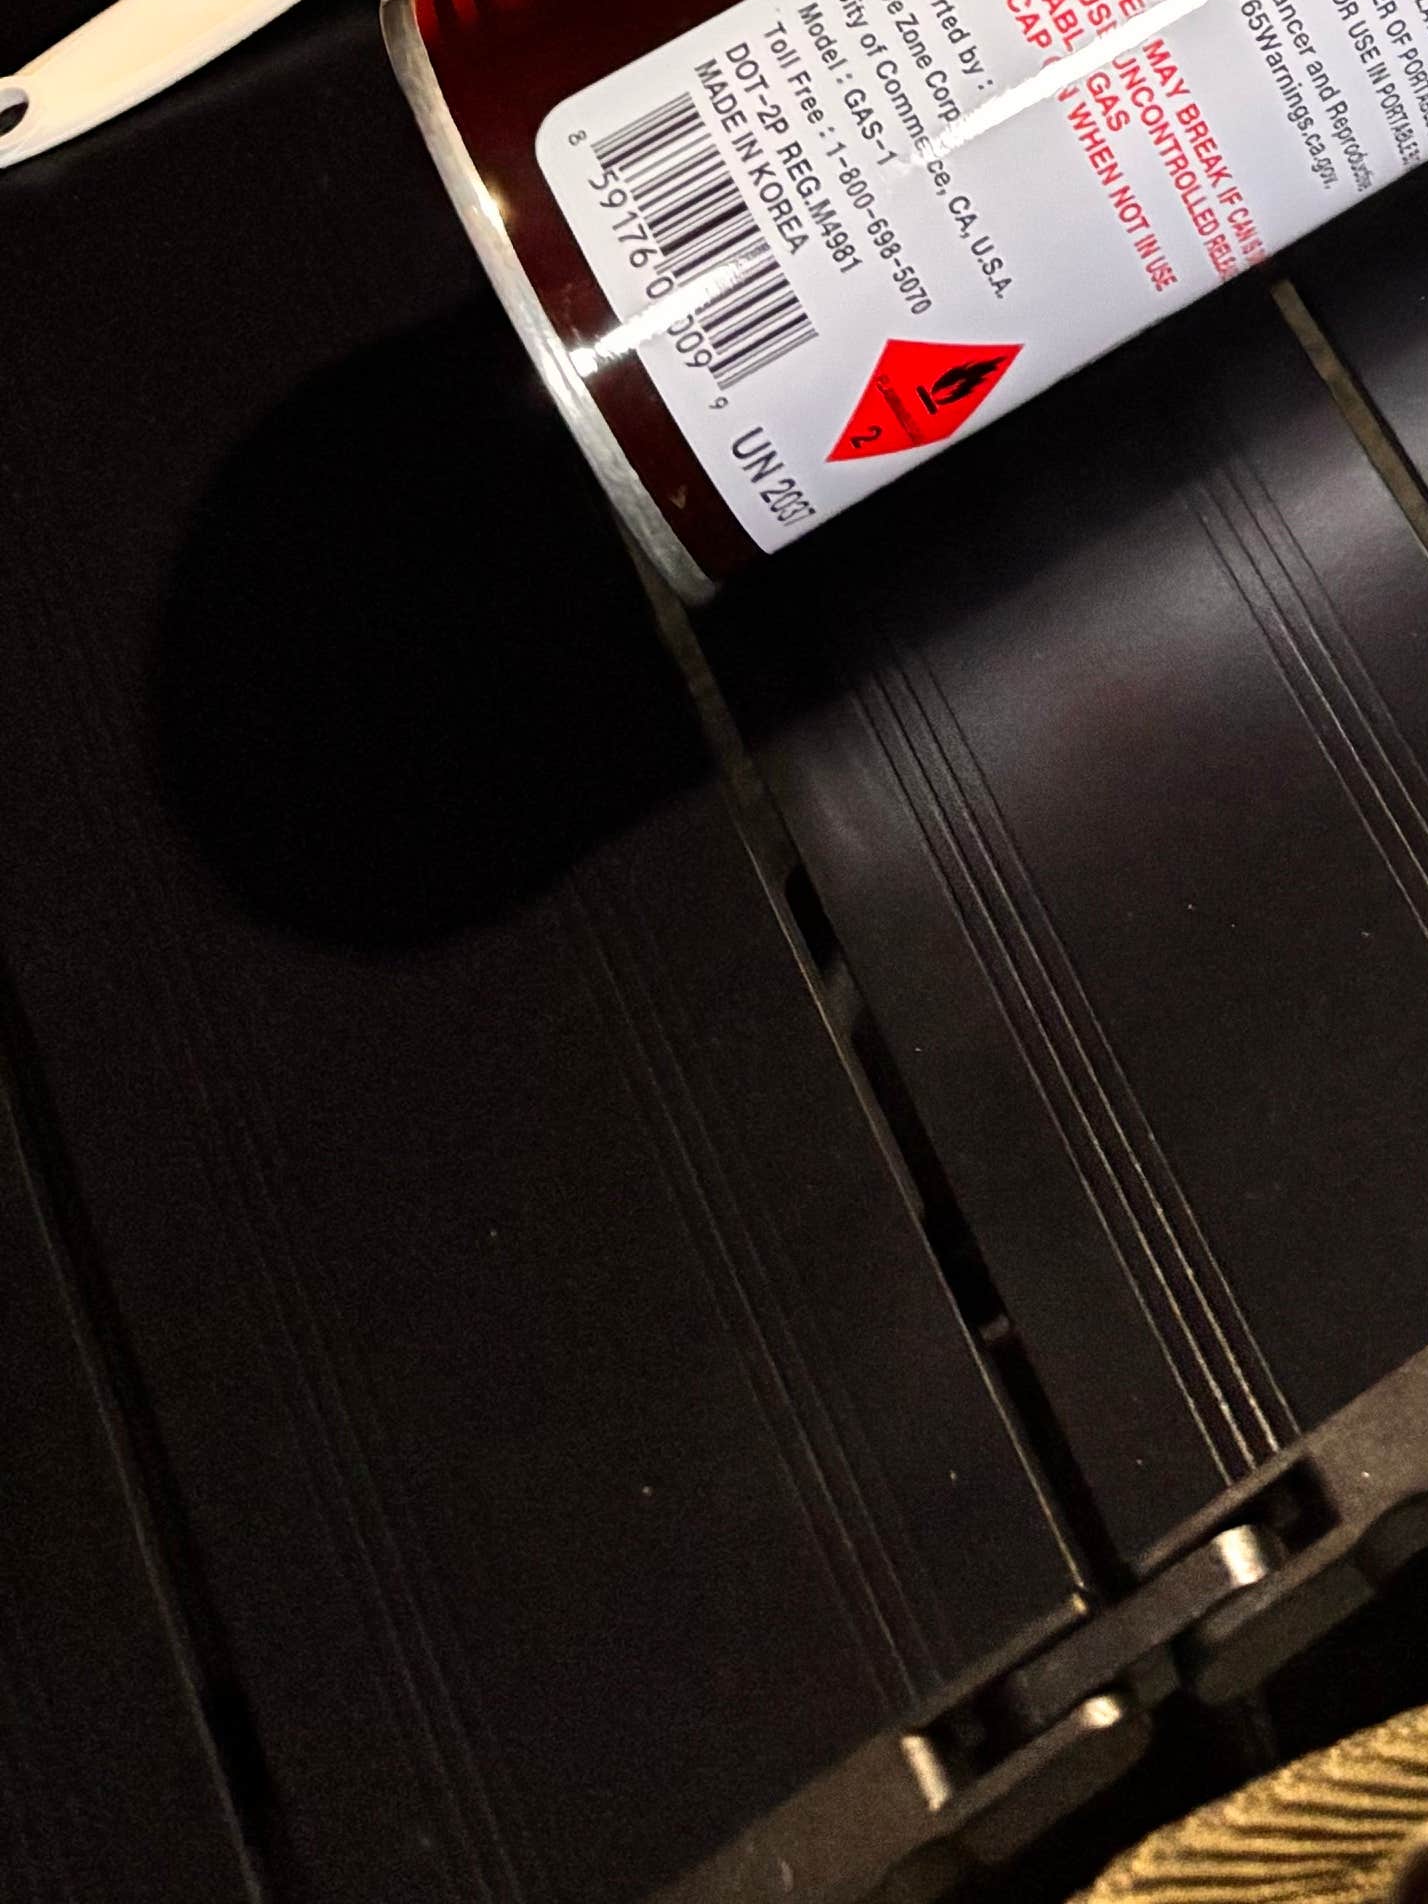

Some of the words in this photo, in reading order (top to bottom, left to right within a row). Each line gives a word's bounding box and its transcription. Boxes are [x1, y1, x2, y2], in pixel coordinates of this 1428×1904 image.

[895, 12, 933, 70] Zone
[958, 45, 985, 75] by
[1348, 19, 1381, 64] USE
[1386, 19, 1413, 46] OF
[694, 58, 748, 134] MADE
[797, 2, 848, 71] Model
[844, 88, 898, 166] GAS-1
[1142, 38, 1191, 98] MAY
[1306, 60, 1341, 103] and
[1366, 61, 1391, 85] IN
[1086, 71, 1131, 132] GAS
[1375, 82, 1418, 155] PORTABLE
[725, 42, 790, 135] DOT-2P
[776, 140, 863, 274] REG.M4981
[731, 131, 764, 163] IN
[764, 20, 801, 69] Toll
[787, 70, 824, 124] Free
[826, 141, 933, 315] 1-800-698-5070
[860, 33, 888, 57] of
[948, 195, 978, 240] CA,
[970, 235, 1013, 300] U.S.A.
[1067, 101, 1124, 186] WHEN
[1175, 103, 1233, 188] BREAK
[747, 161, 810, 256] KOREA
[1108, 185, 1151, 234] NOT
[1216, 186, 1244, 205] IF
[1227, 207, 1256, 243] CAN
[568, 130, 587, 147] 8
[709, 396, 729, 410] 9
[1134, 233, 1161, 260] IN
[1145, 255, 1178, 292] USE
[846, 424, 888, 453] 2
[731, 426, 785, 484] UN
[759, 478, 817, 527] 2037
